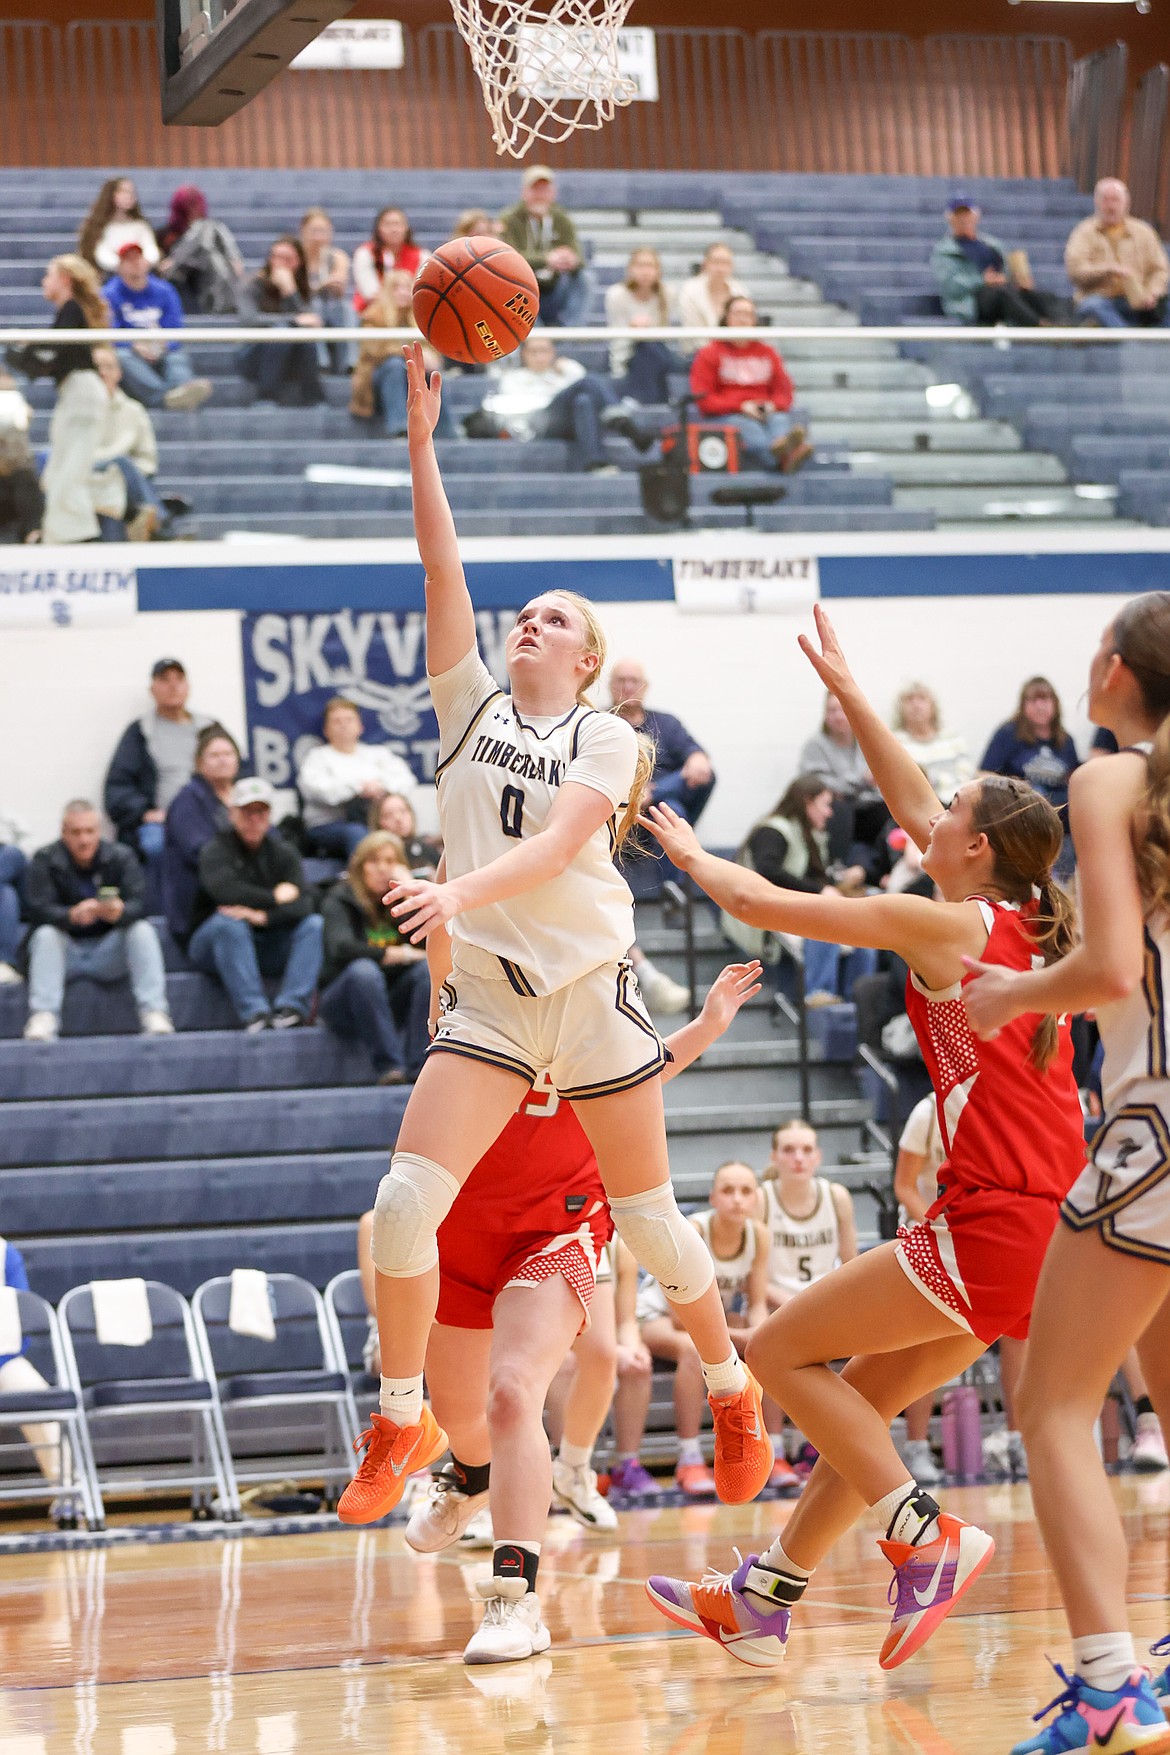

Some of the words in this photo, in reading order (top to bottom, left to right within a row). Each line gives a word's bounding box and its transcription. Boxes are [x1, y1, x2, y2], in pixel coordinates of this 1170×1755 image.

[470, 735, 566, 787] TIMBERLAK
[500, 784, 525, 839] 0
[798, 1255, 813, 1282] 5
